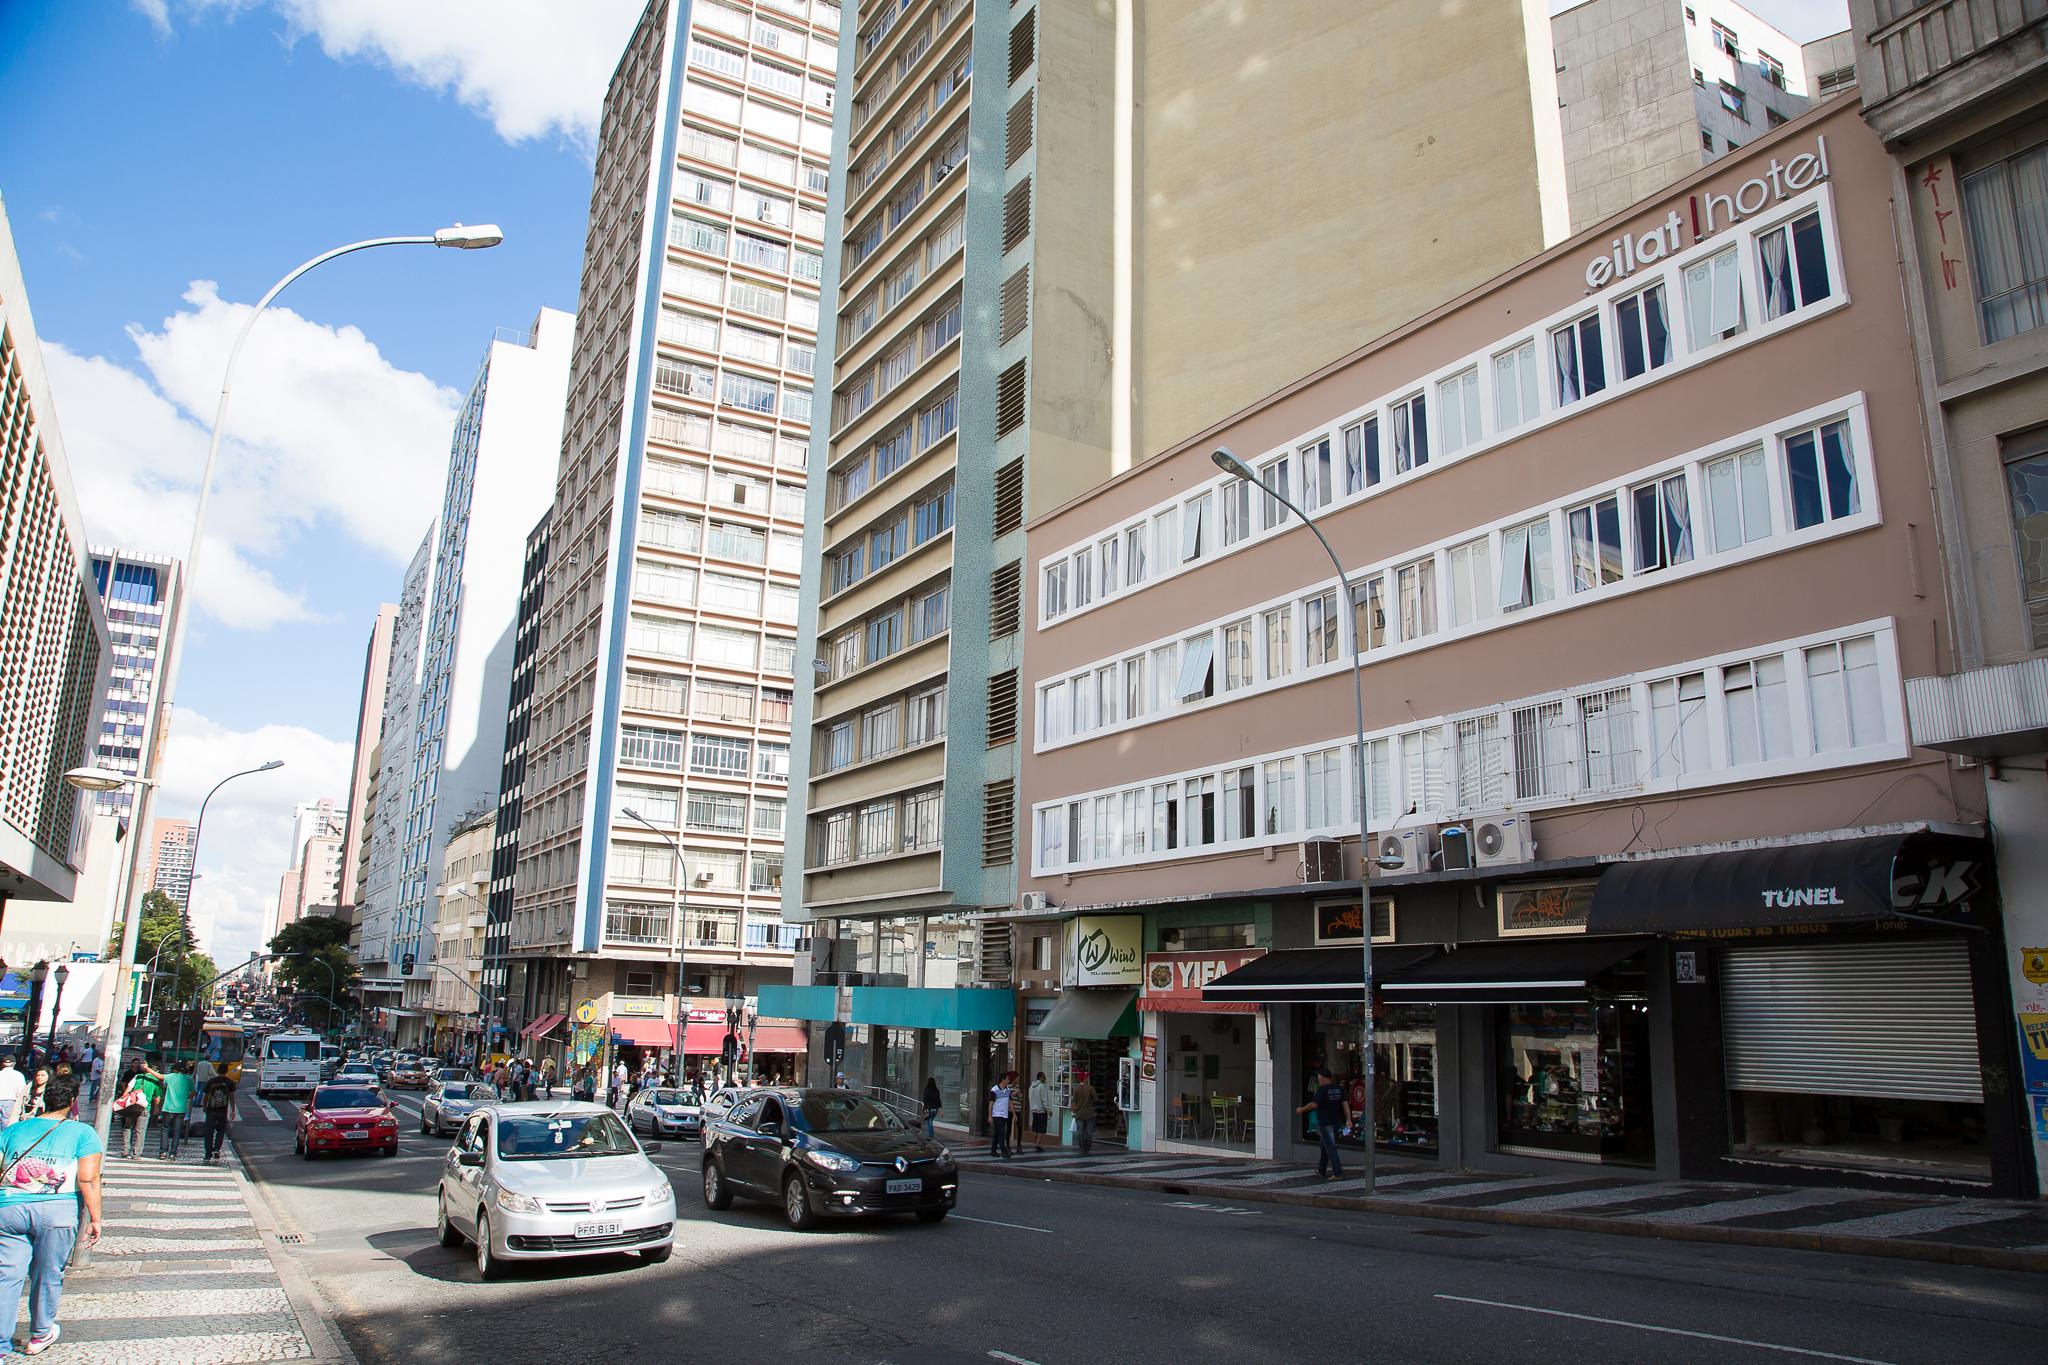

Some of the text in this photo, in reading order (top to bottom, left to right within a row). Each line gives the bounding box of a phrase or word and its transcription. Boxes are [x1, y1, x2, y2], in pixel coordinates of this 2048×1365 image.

[1585, 209, 1683, 289] eilat
[1704, 134, 1832, 233] hotel
[1762, 885, 1845, 908] TÚNEL
[1109, 946, 1136, 965] Wind
